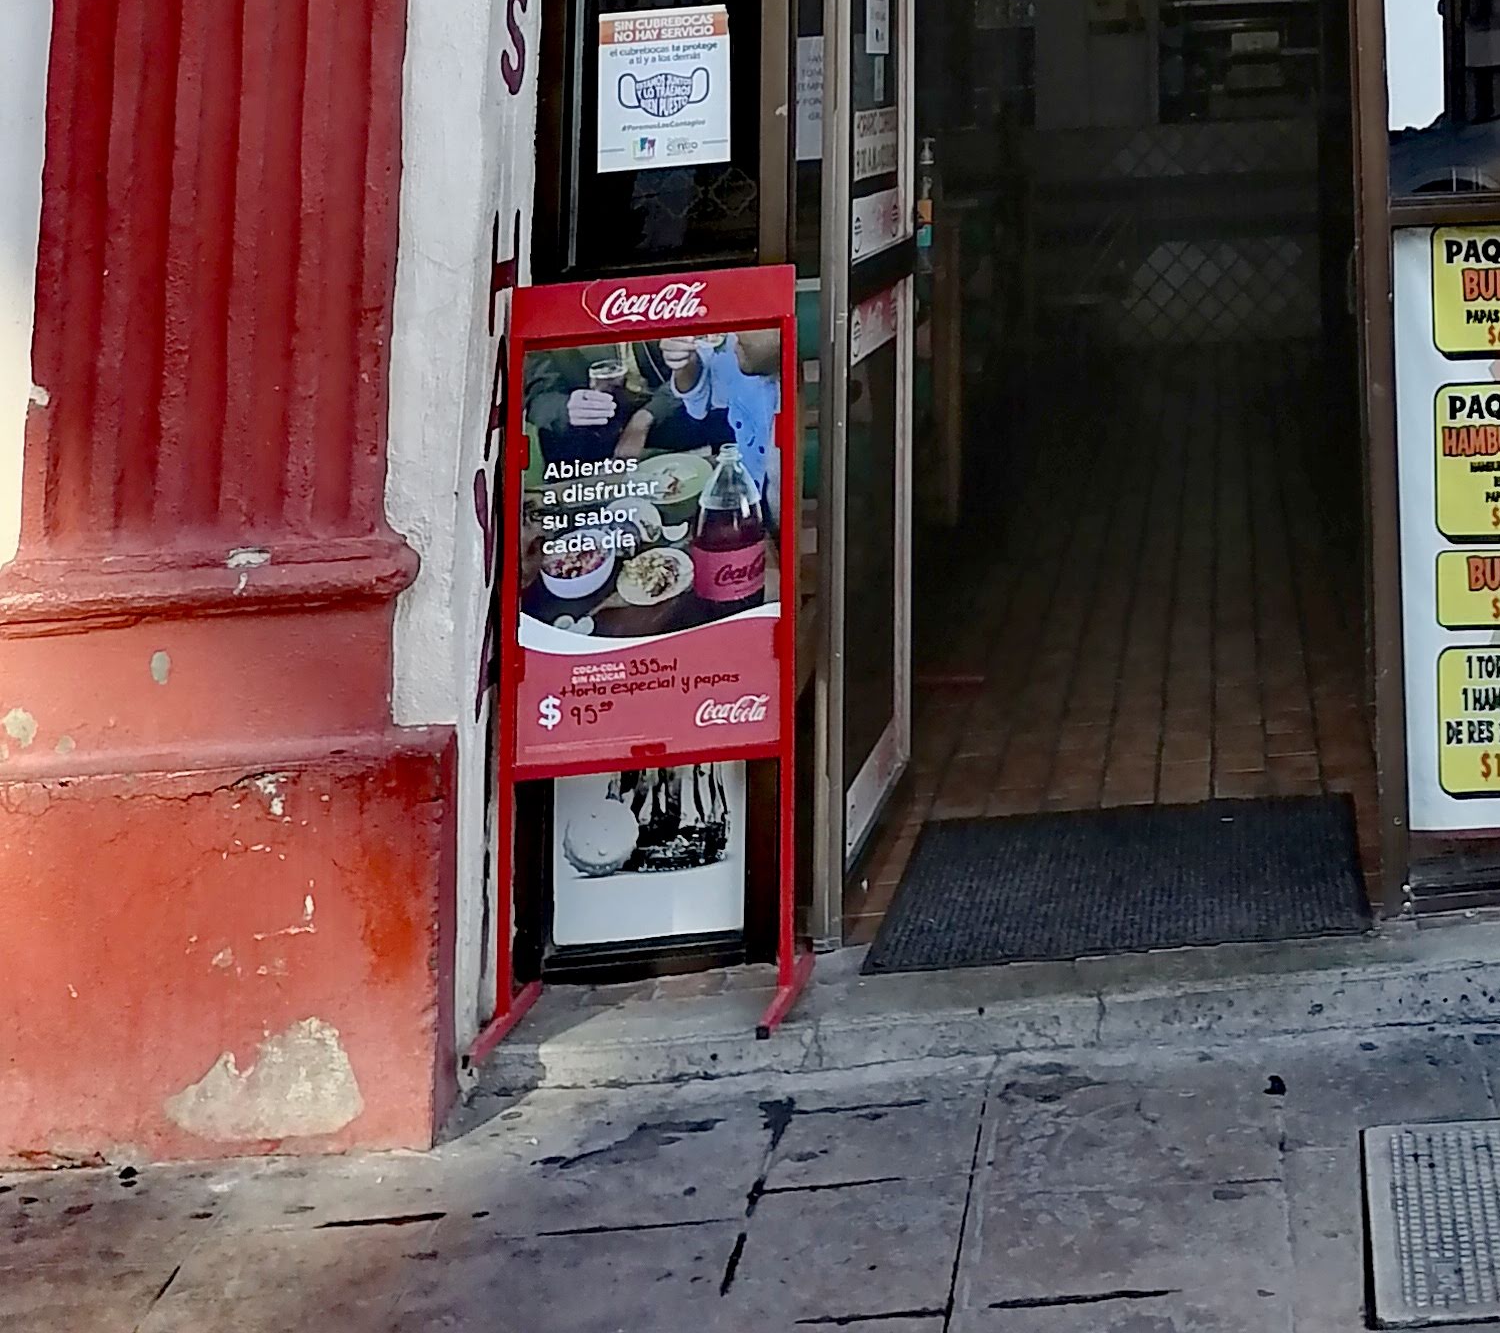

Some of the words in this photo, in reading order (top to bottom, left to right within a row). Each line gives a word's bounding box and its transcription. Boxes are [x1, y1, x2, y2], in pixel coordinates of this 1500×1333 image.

[614, 20, 633, 31] SIN
[635, 14, 714, 30] CUBREBOCAS
[614, 31, 633, 42] NO
[636, 30, 659, 41] HAY
[661, 25, 714, 38] SERVICIO
[619, 45, 670, 57] cubrebocas
[672, 43, 681, 52] te
[683, 41, 718, 53] protege
[658, 53, 671, 62] los
[600, 282, 708, 325] Coca-Cola
[1466, 309, 1500, 324] PAPAS
[544, 457, 638, 480] Abiertos
[543, 491, 556, 505] a
[563, 480, 658, 503] disfrutar
[543, 516, 568, 530] su
[575, 506, 638, 526] sabor
[542, 534, 596, 555] cada
[601, 529, 636, 550] día
[573, 662, 625, 675] COCA-COLA
[1466, 656, 1473, 679] 1
[571, 675, 587, 685] SIN
[611, 676, 676, 696] especial
[681, 677, 691, 693] y
[694, 672, 740, 690] papas
[1462, 688, 1469, 711] 1
[538, 695, 562, 730] $
[1446, 720, 1465, 745] DE
[1467, 720, 1494, 743] RES
